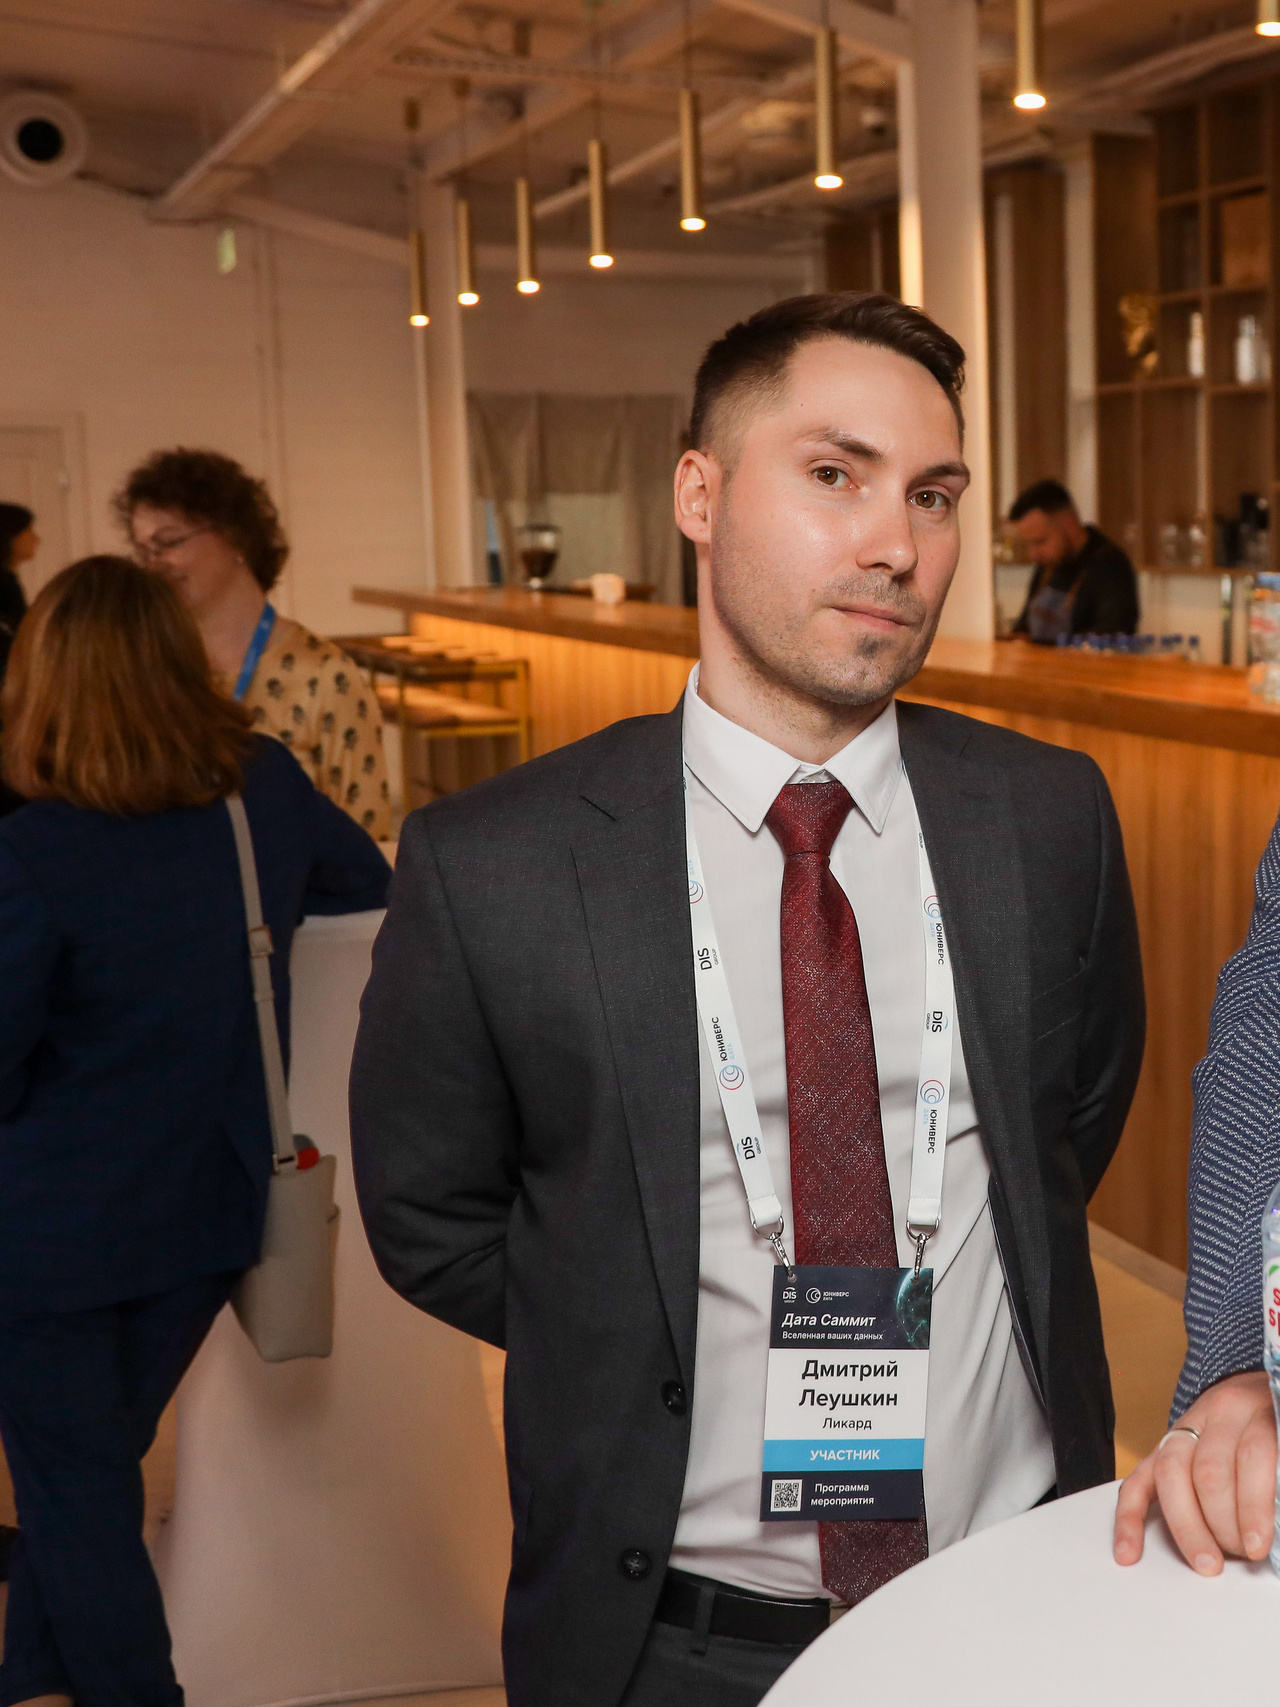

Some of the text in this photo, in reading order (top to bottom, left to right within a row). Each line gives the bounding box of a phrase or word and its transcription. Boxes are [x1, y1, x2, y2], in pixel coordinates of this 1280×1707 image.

[935, 922, 945, 966] ЮНИВЕРС
[697, 947, 713, 971] DIS
[931, 1010, 943, 1033] DIS
[711, 1016, 728, 1062] ЮНИВЕРС
[927, 1109, 938, 1154] ЮНИВЕРС
[740, 1136, 756, 1160] DIS
[782, 1291, 797, 1300] DIS
[781, 1312, 876, 1328] Дата Саммит
[782, 1331, 884, 1341] Вселенная ваших данных
[801, 1360, 898, 1381] Дмитрий
[799, 1389, 898, 1411] Леушкин
[822, 1417, 872, 1431] Ликард
[810, 1449, 881, 1461] УЧАСТНИК
[814, 1483, 870, 1494] Программа
[810, 1497, 875, 1507] мероприятия
